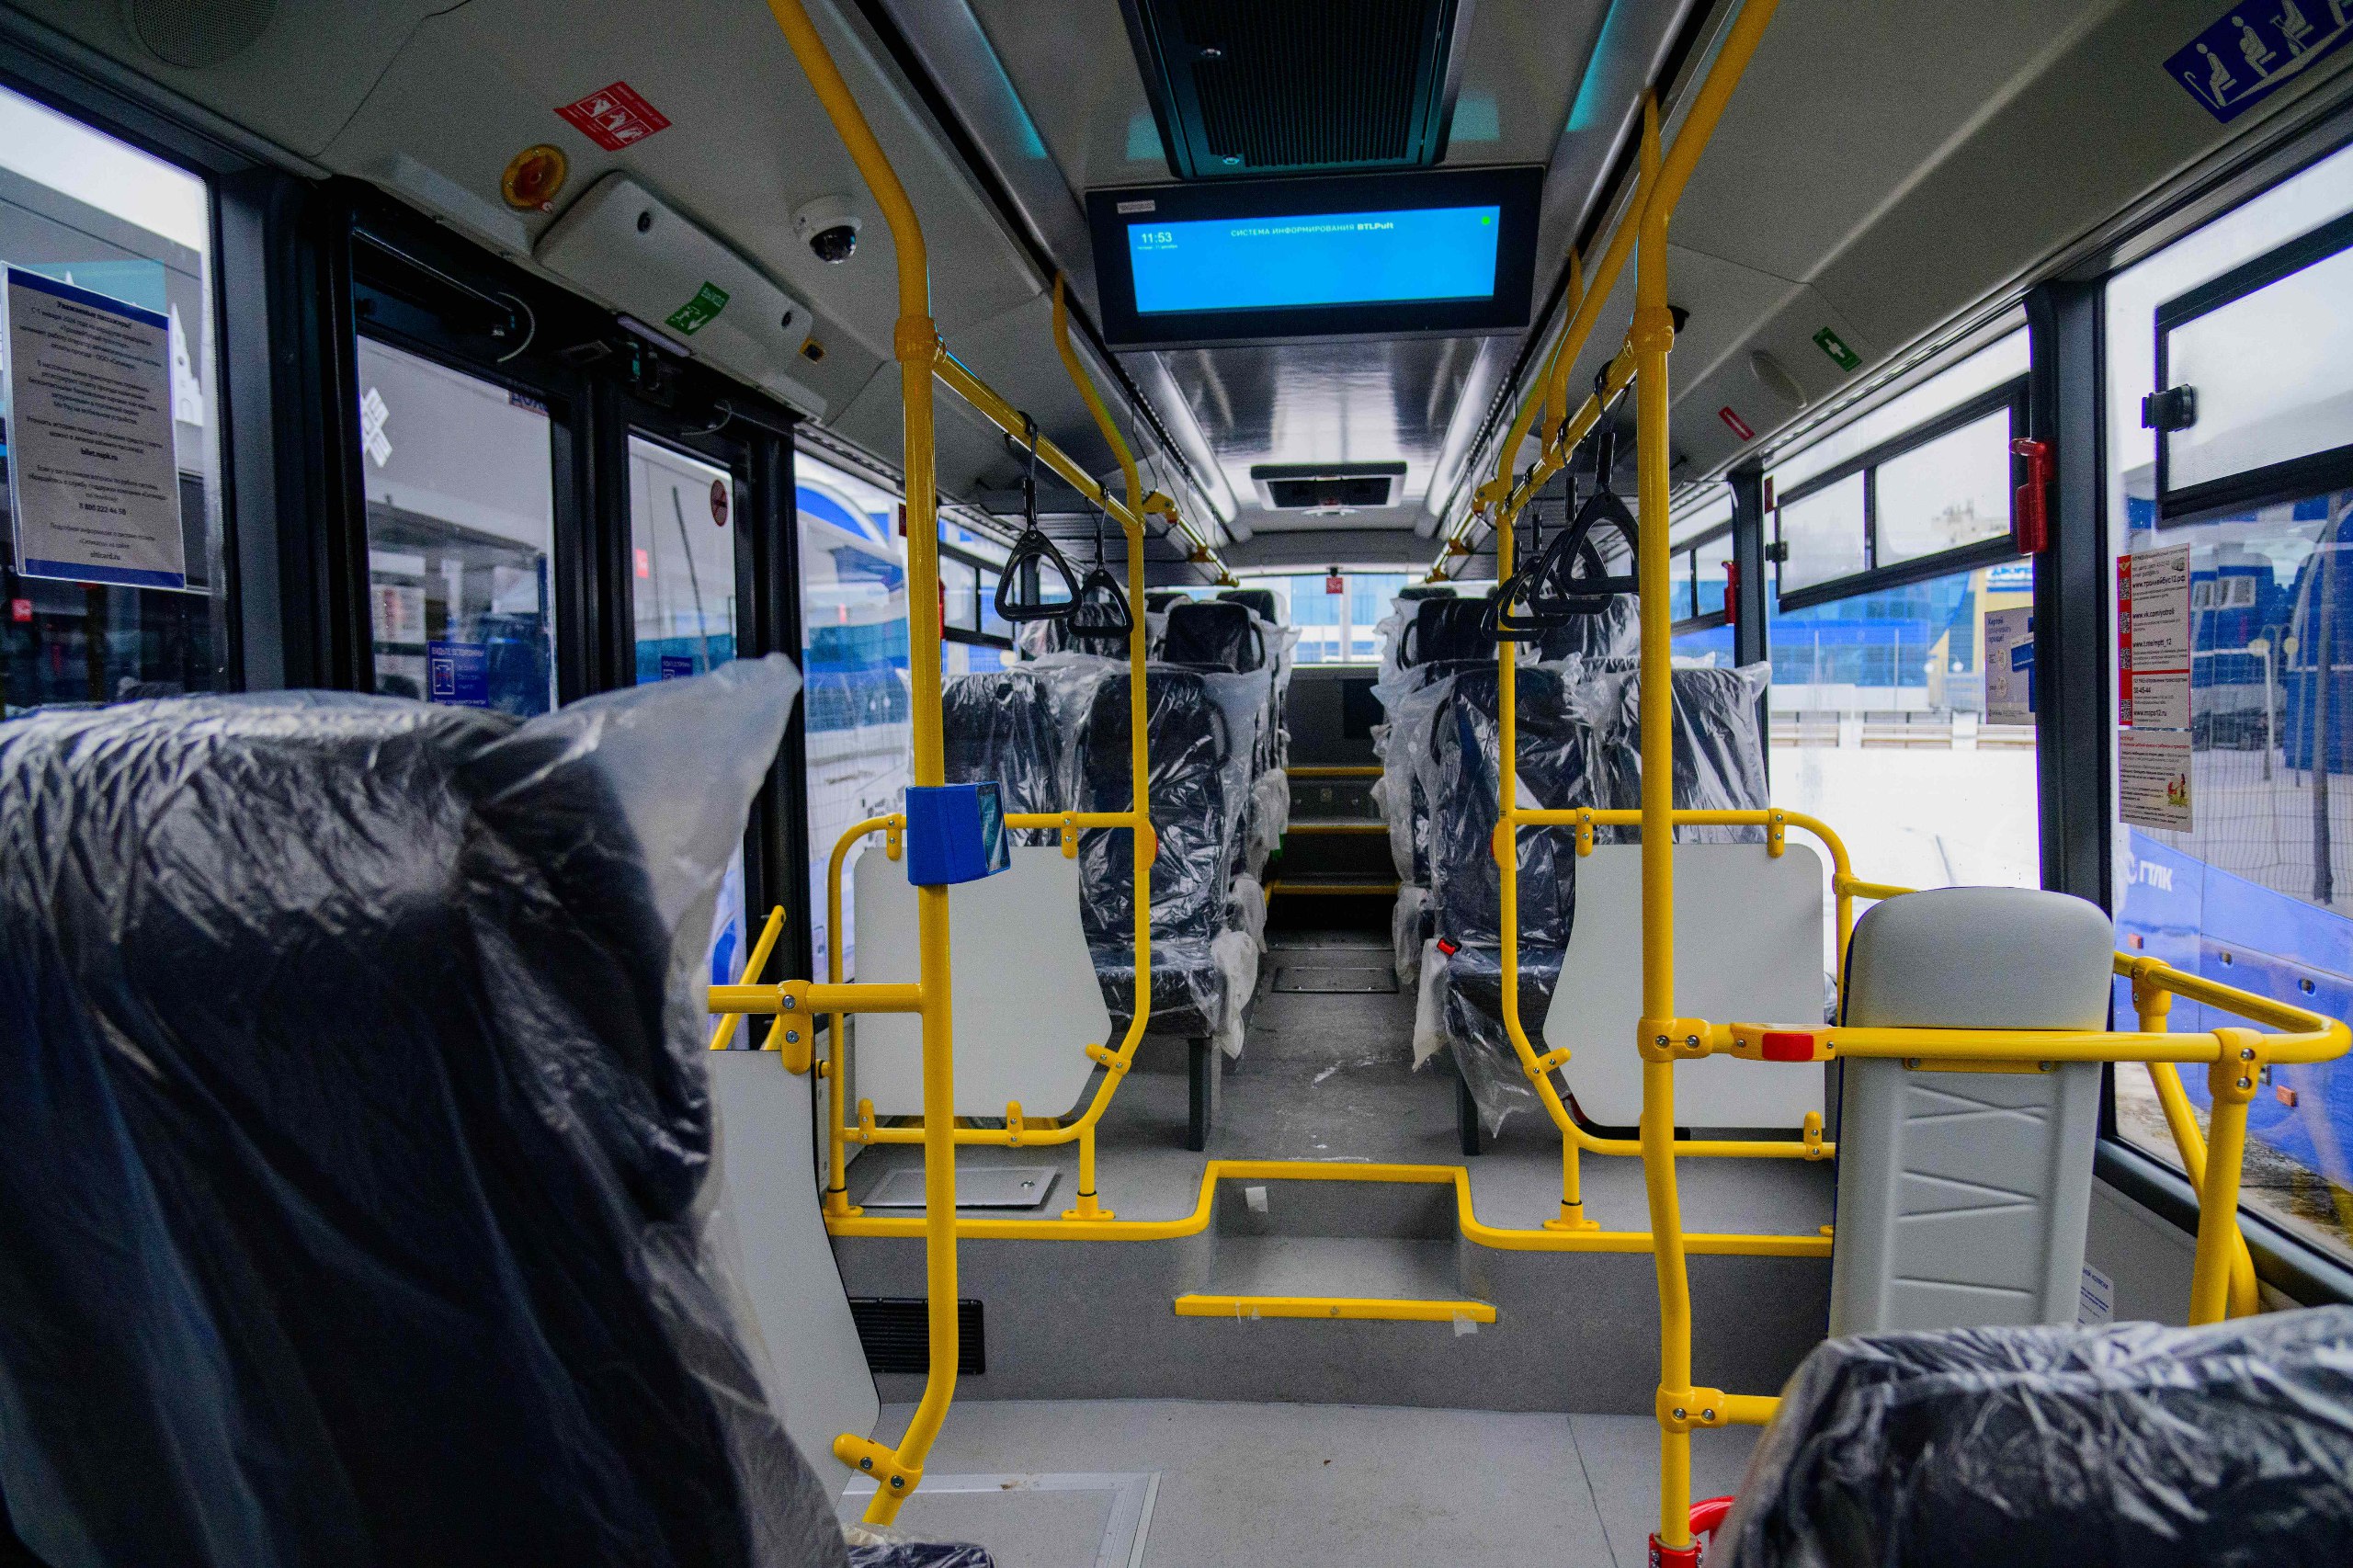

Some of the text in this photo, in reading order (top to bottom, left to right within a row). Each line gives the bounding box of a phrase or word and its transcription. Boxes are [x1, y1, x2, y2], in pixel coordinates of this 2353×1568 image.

[1231, 222, 1394, 237] СИСТЕМА ИНФОРМИРОВАНИЯ BTLPult
[1142, 232, 1173, 244] 11:53
[97, 505, 108, 513] 222
